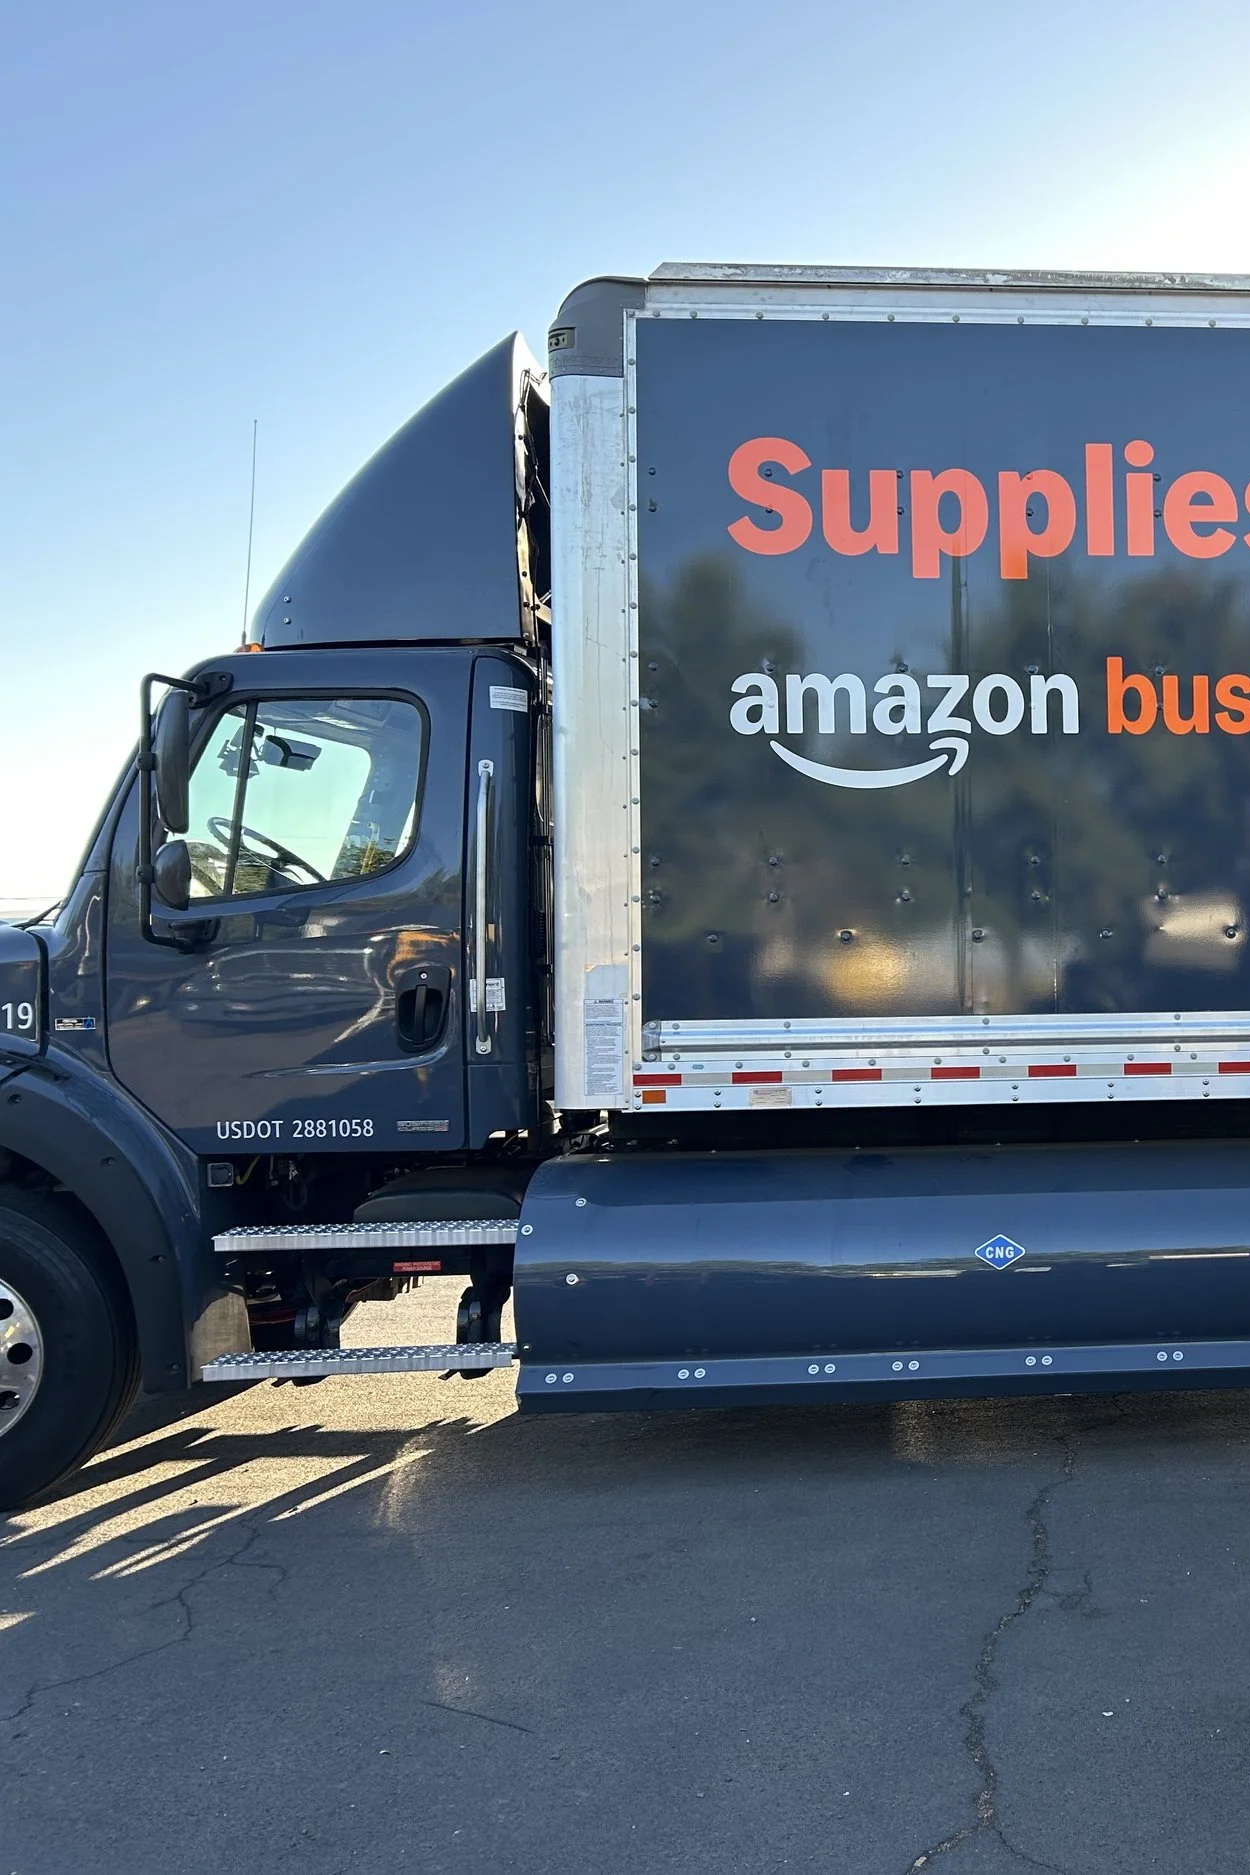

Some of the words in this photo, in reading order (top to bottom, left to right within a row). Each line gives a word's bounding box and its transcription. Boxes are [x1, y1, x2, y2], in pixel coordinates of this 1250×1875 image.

[729, 672, 1079, 737] amazon
[1, 1002, 33, 1030] 19
[217, 1120, 284, 1139] USDOT
[292, 1119, 374, 1138] 2881058
[985, 1246, 1015, 1259] CNG
